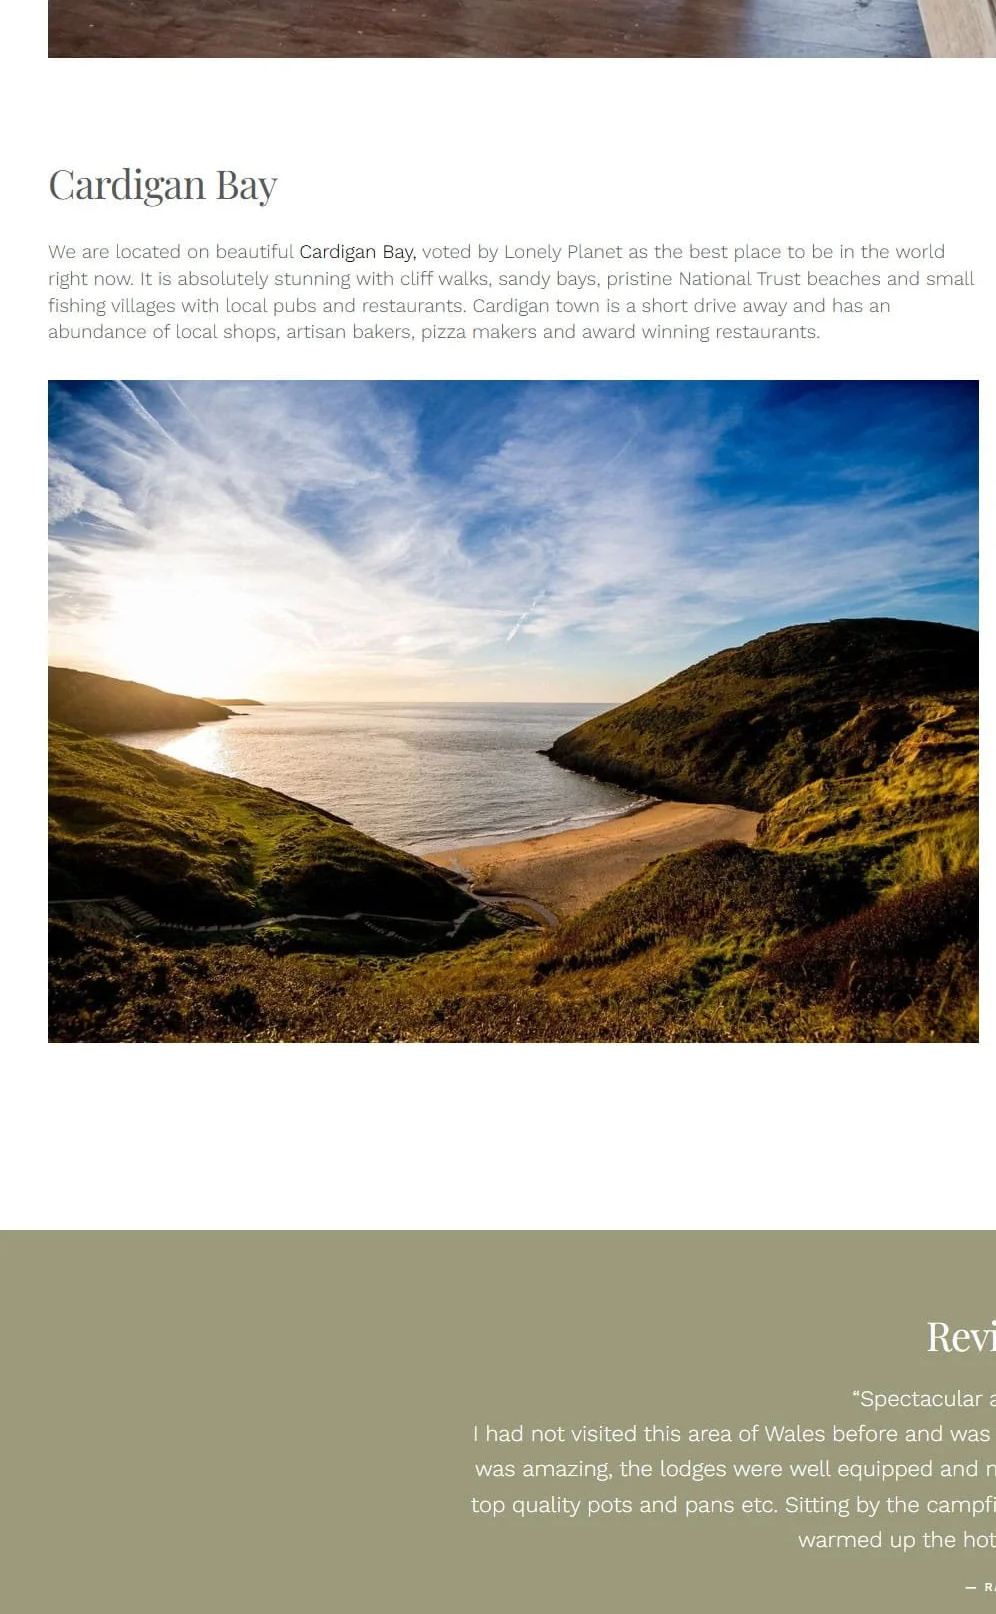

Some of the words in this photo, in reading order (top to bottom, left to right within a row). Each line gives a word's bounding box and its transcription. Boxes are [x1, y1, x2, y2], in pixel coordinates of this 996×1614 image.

[49, 167, 207, 208] Cardigan
[215, 170, 279, 208] Bay
[47, 244, 77, 260] We
[81, 247, 110, 260] are
[116, 242, 181, 259] located
[187, 247, 210, 259] on
[216, 243, 295, 259] beautiful
[299, 242, 376, 263] Cardigan
[383, 244, 417, 263] Bay,
[421, 242, 471, 260] voted
[478, 243, 499, 263] by
[504, 243, 563, 263] Lonely
[567, 243, 624, 259] Planet
[628, 247, 649, 260] as
[653, 243, 683, 259] the
[689, 243, 729, 259] best
[734, 243, 782, 263] place
[786, 245, 806, 259] to
[812, 242, 834, 259] be
[839, 243, 855, 259] in
[860, 243, 890, 260] the
[895, 242, 945, 260] world
[473, 1425, 478, 1442] I
[486, 1424, 523, 1443] had
[531, 1426, 566, 1443] not
[570, 1424, 637, 1443] visited
[643, 1424, 681, 1443] this
[688, 1428, 733, 1443] area
[738, 1423, 760, 1442] of
[764, 1424, 826, 1443] Wales
[832, 1424, 898, 1443] before
[905, 1424, 943, 1443] and
[949, 1428, 991, 1443] was
